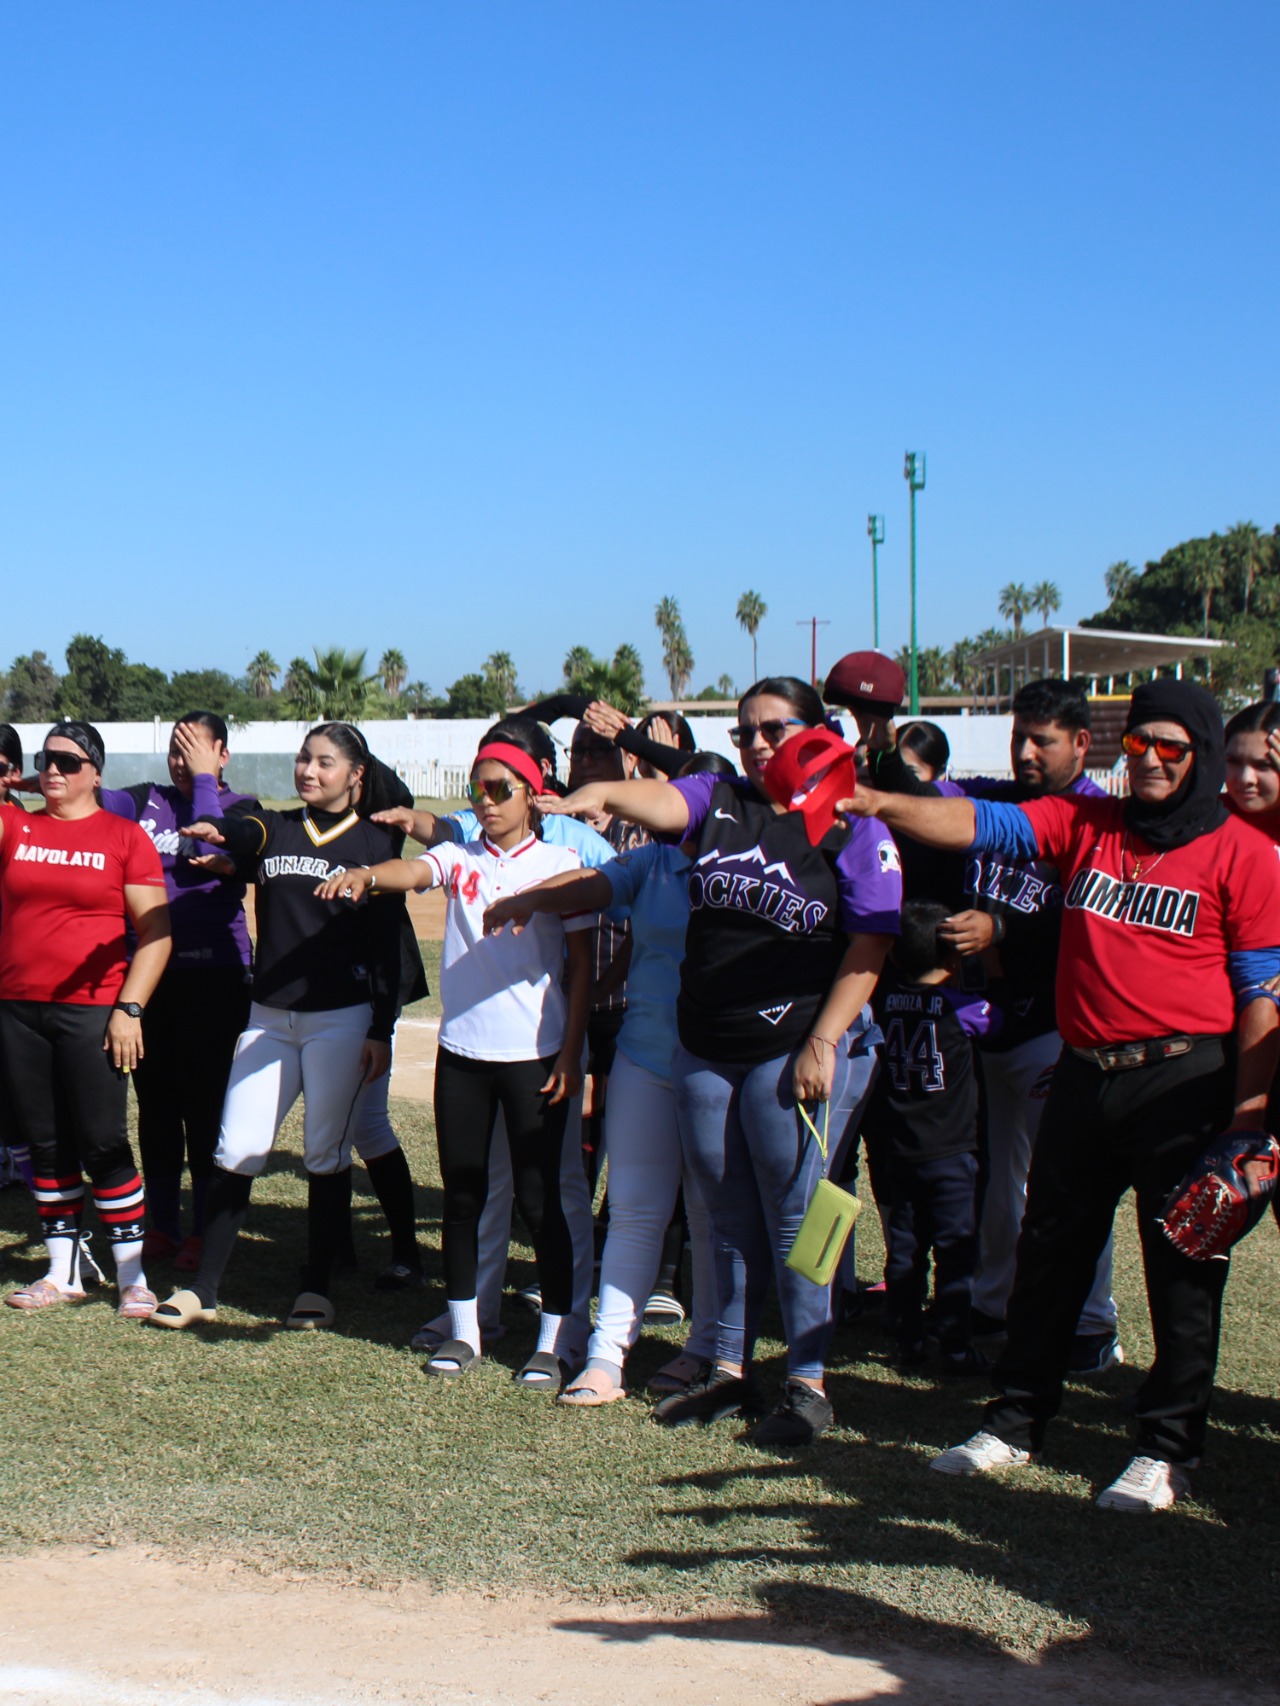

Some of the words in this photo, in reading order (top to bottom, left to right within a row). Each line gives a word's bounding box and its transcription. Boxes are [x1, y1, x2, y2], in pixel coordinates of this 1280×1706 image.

[13, 842, 106, 871] NAVOLATO
[688, 871, 829, 934] OCKIES
[927, 996, 944, 1016] JR
[885, 1018, 945, 1091] 44
